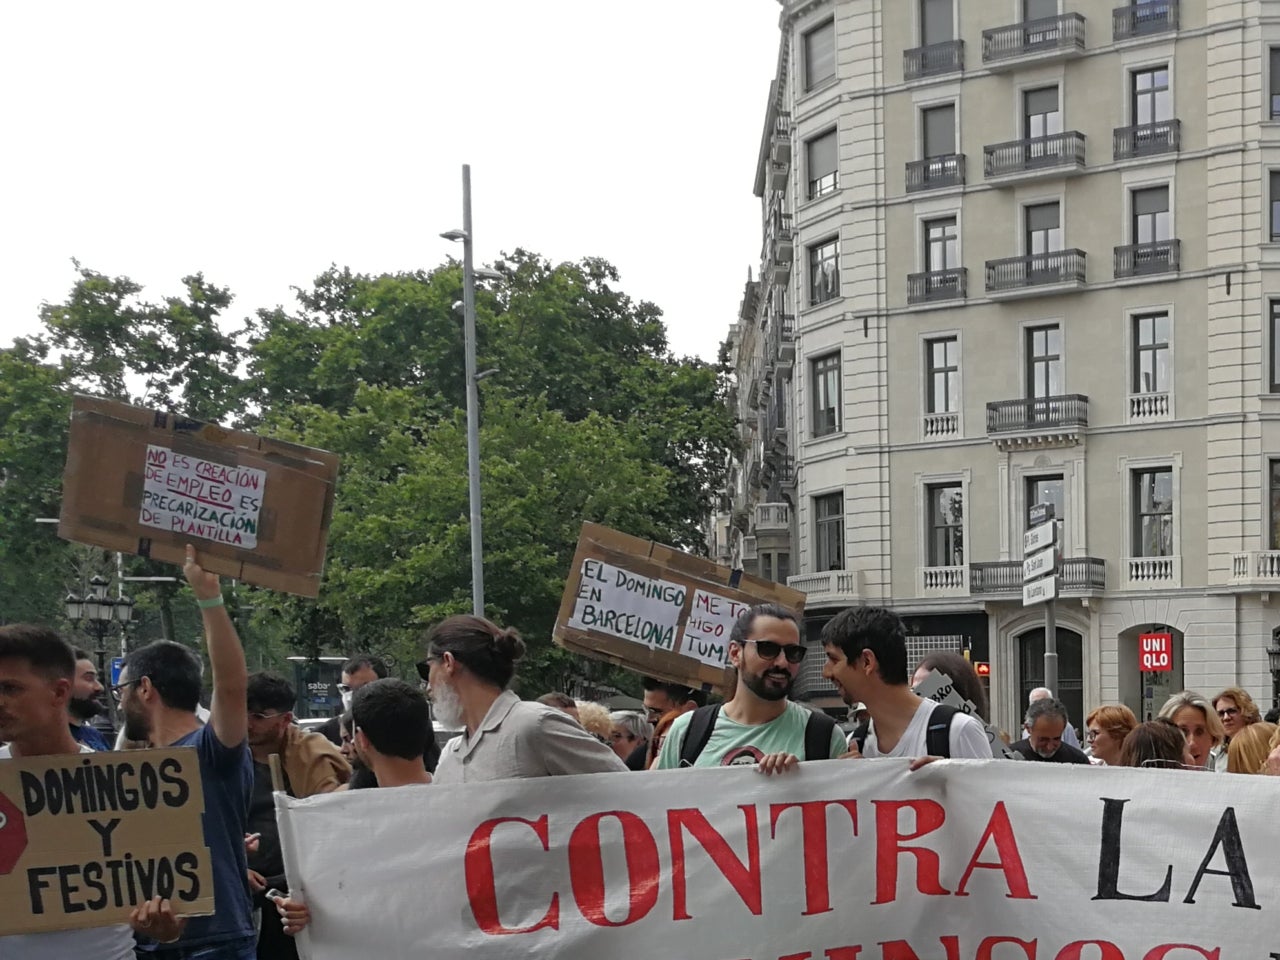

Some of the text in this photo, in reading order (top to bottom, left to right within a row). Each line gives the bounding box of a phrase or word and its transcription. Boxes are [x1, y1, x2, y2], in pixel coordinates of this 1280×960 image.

[147, 448, 167, 469] NO
[172, 454, 190, 470] ES
[144, 466, 259, 512] DE EMPLEO ES
[142, 508, 161, 525] DE
[584, 560, 607, 583] EL
[577, 584, 602, 602] EN
[696, 593, 721, 616] ME
[581, 604, 674, 650] BARCELONA
[1143, 638, 1166, 651] UNI
[1143, 653, 1168, 669] QLO
[88, 818, 121, 857] Y
[464, 799, 1037, 936] CONTRA
[1091, 798, 1261, 910] LA
